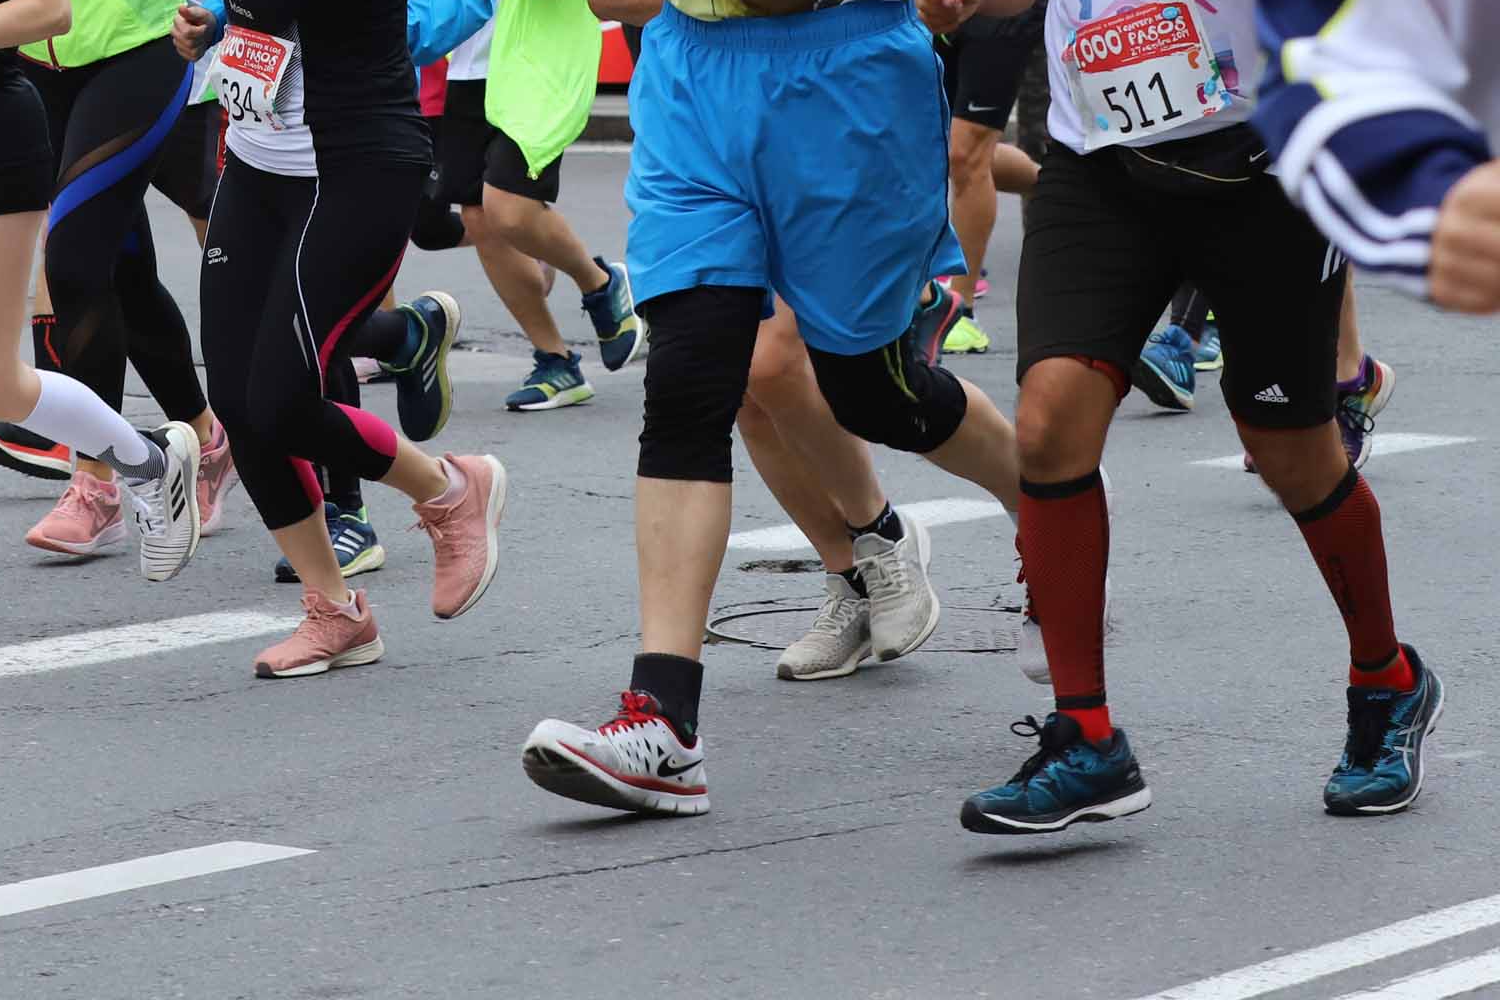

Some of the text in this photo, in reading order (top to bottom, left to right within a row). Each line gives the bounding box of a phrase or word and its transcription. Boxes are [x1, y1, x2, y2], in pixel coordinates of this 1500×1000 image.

[1127, 16, 1186, 47] PASOS
[1130, 45, 1142, 57] 27
[1171, 29, 1190, 42] 2019
[246, 47, 279, 67] PASOS
[1102, 72, 1183, 133] 511
[1254, 394, 1289, 403] adidas
